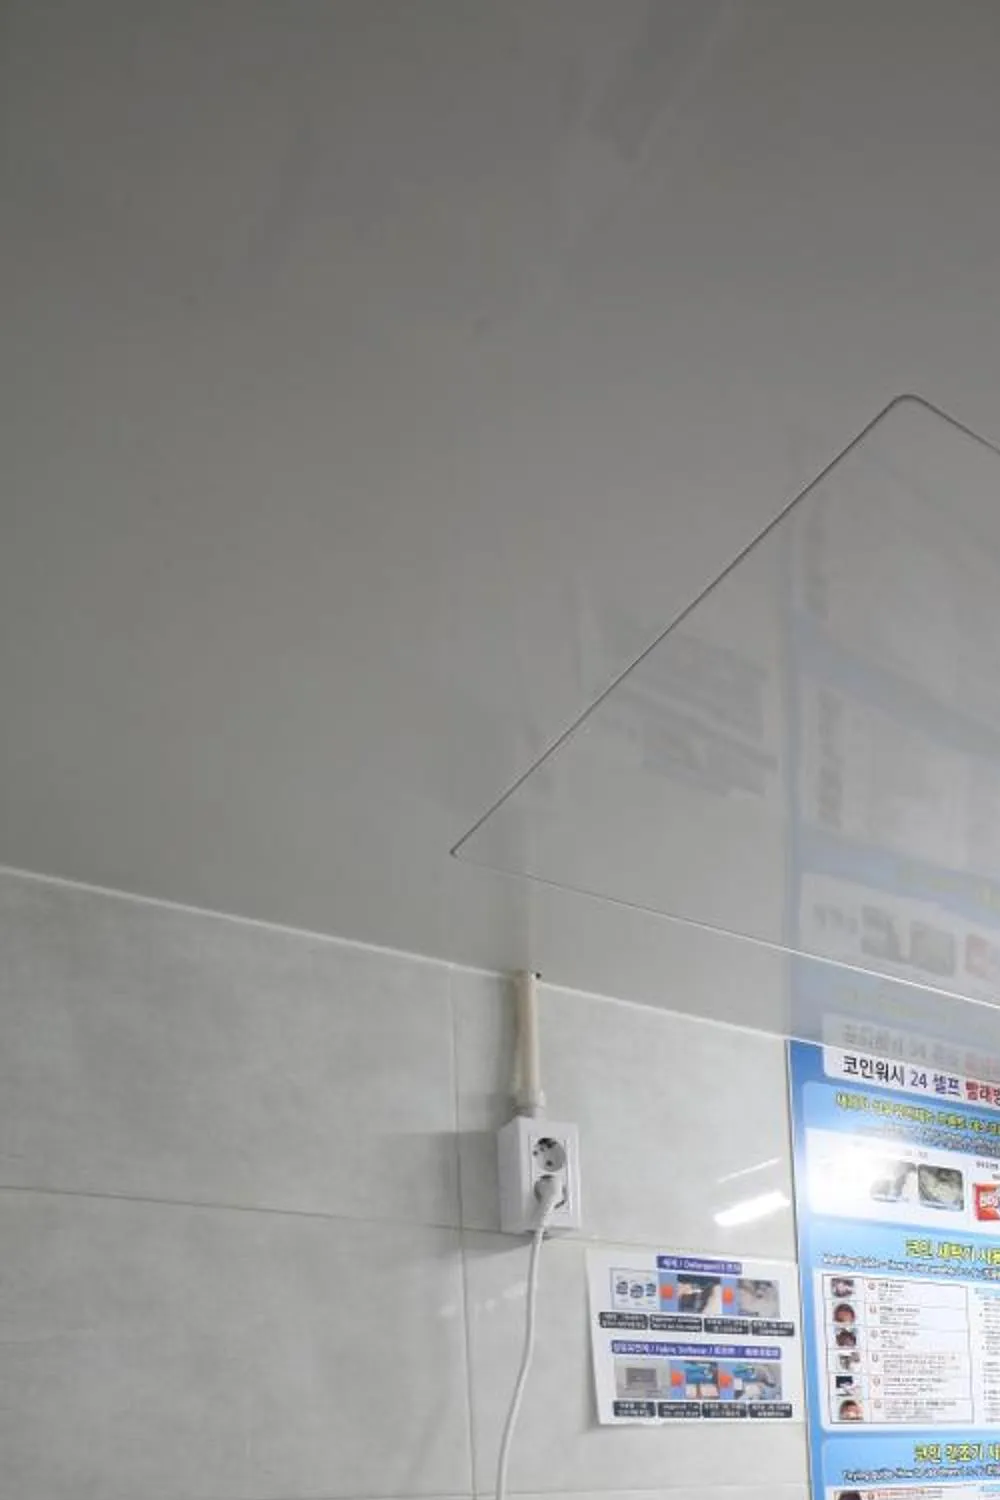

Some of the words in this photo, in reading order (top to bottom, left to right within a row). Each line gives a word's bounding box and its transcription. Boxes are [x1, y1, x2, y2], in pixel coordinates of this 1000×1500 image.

[843, 1054, 905, 1086] 코인워시
[910, 1069, 928, 1089] 24
[932, 1075, 961, 1098] 셀프
